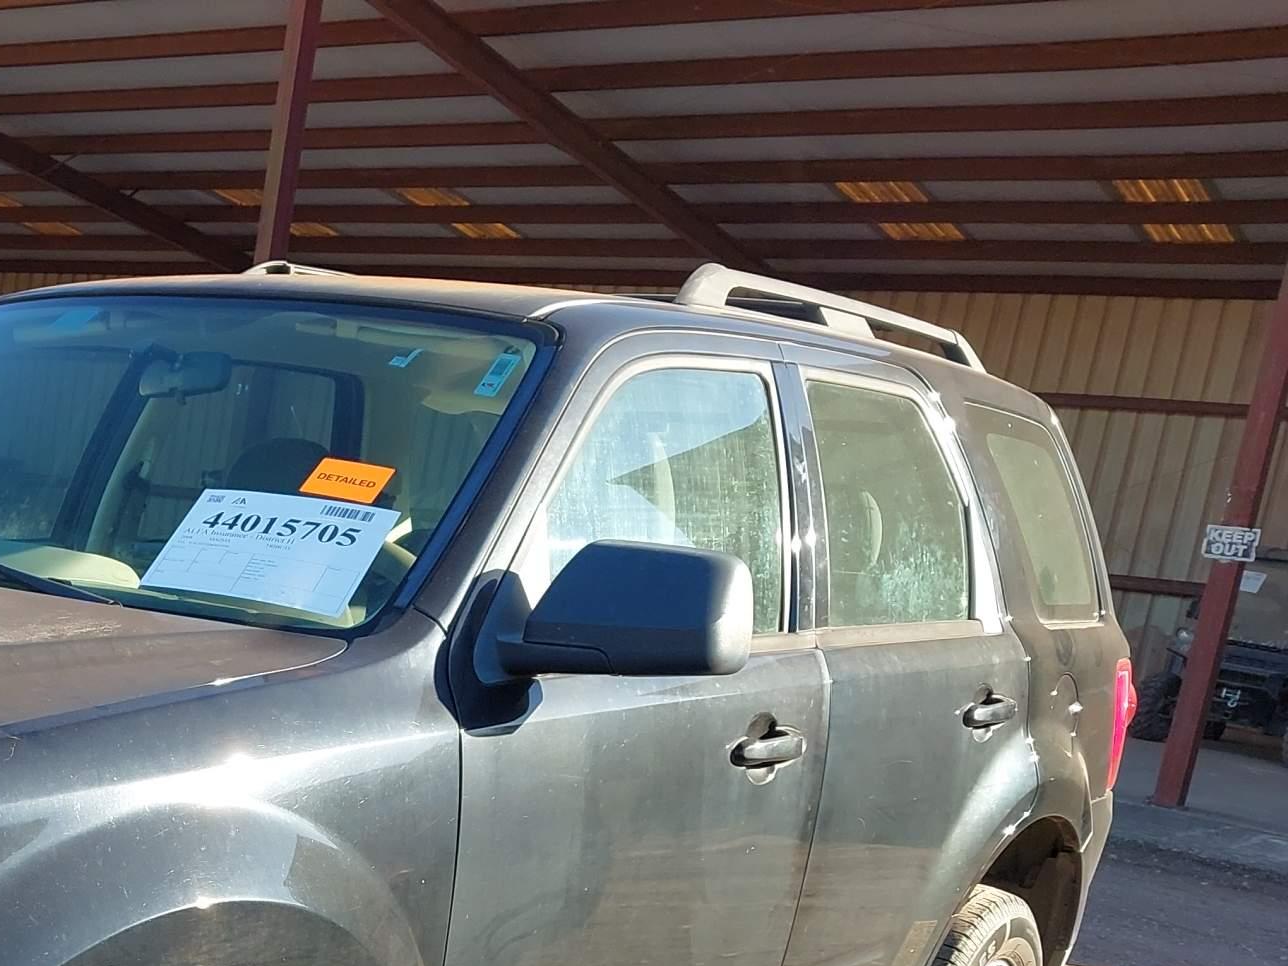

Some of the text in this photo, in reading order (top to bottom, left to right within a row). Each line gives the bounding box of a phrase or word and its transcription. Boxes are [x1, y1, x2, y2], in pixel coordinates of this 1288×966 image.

[316, 472, 377, 489] DETAILED
[202, 511, 362, 547] 44015705
[1209, 529, 1256, 544] KEEP
[1211, 542, 1247, 557] OUT
